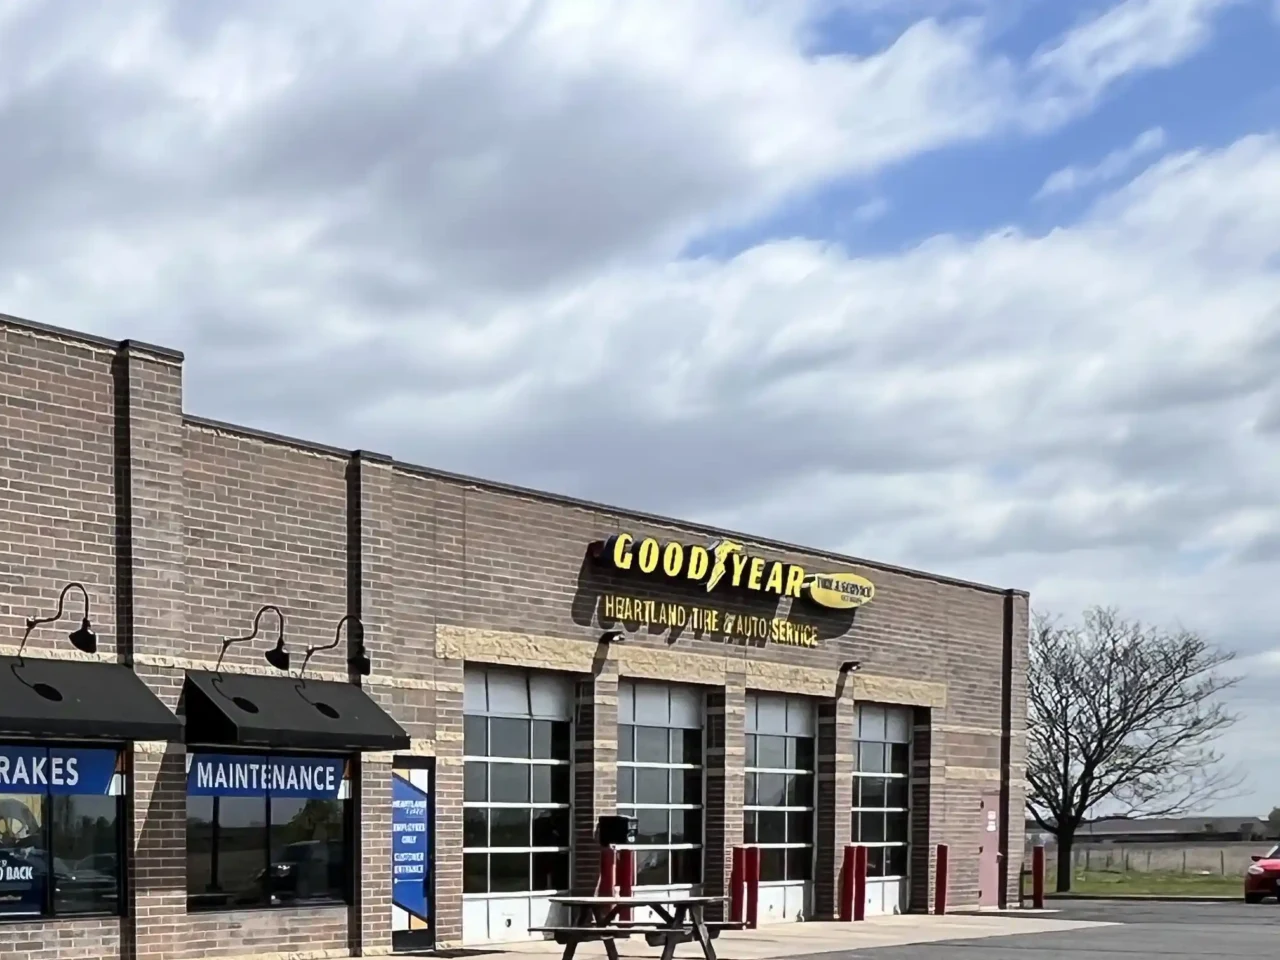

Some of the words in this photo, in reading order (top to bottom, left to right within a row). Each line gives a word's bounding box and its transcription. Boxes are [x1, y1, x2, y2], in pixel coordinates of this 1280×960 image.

[613, 532, 805, 598] GOODYEAR
[605, 595, 686, 627] HEARTLAND
[692, 607, 719, 633] TIRE
[723, 613, 736, 636] &
[736, 616, 767, 639] AUTO
[770, 620, 819, 647] SERVICE
[196, 761, 336, 792] MAINTENANCE
[6, 865, 34, 880] BACK
